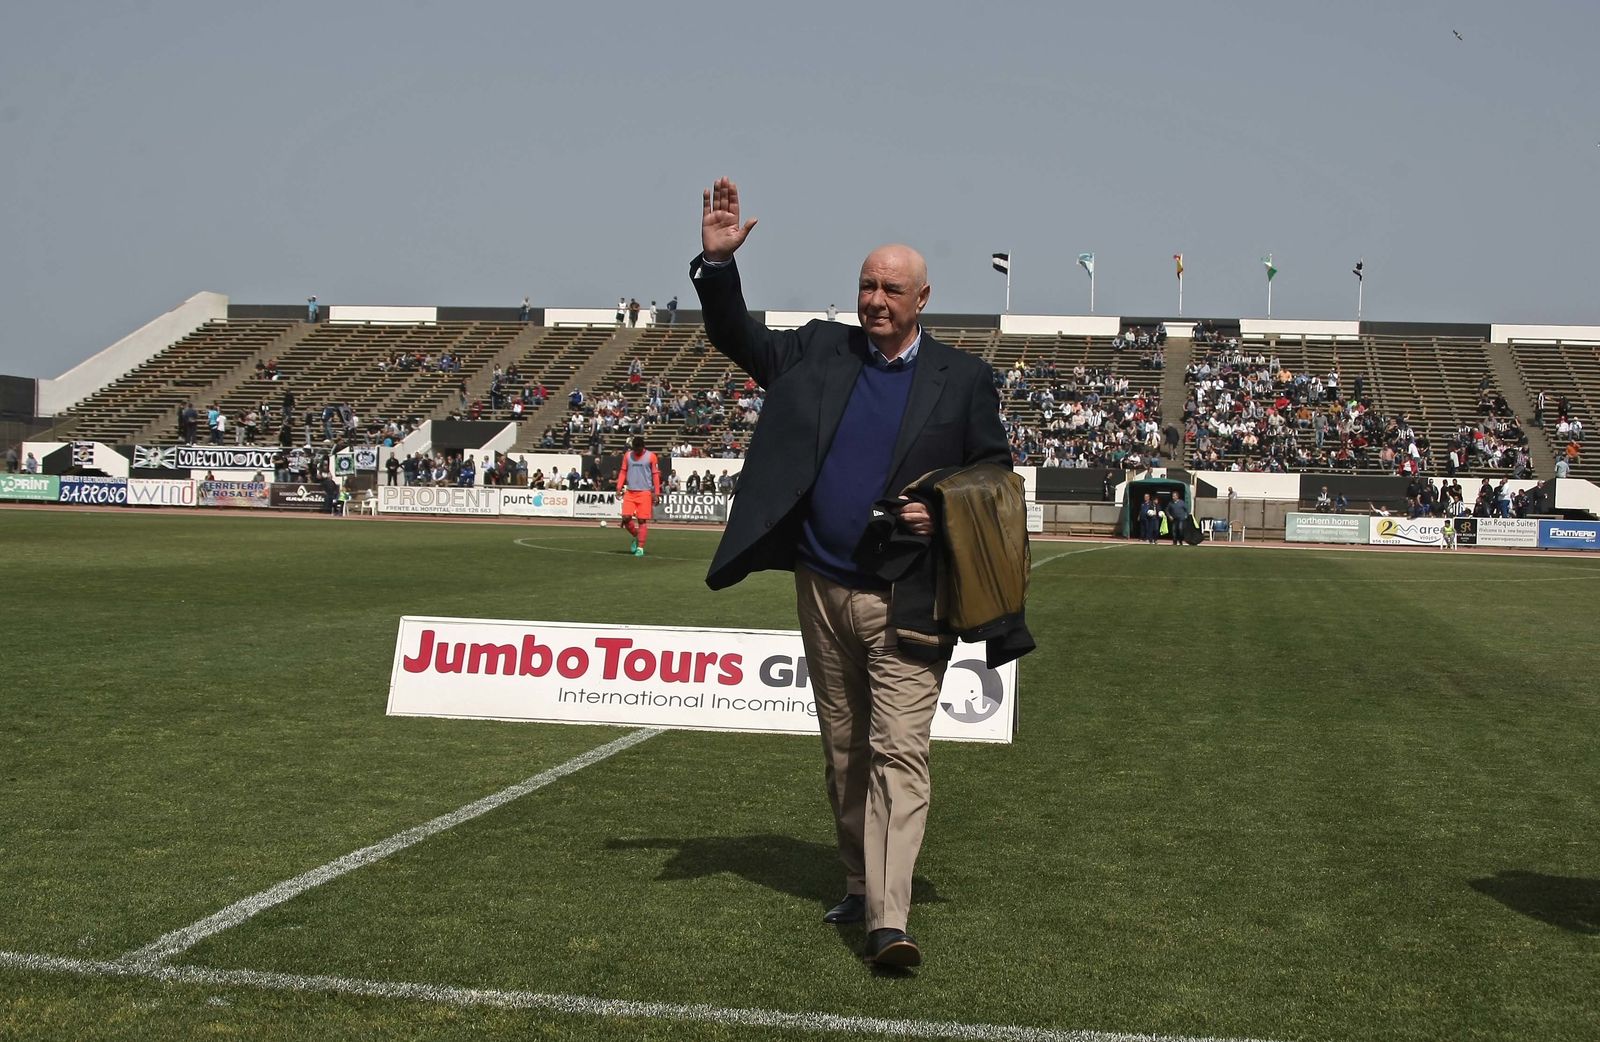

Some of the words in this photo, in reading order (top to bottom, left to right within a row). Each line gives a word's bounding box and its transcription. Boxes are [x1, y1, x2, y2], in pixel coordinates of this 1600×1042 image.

[179, 450, 233, 466] COLECTIVO
[60, 484, 127, 503] BARROSO
[212, 490, 256, 498] ROSAJE
[383, 487, 495, 507] PRODENT
[576, 494, 615, 505] MIPAN
[1296, 516, 1330, 525] northern
[1332, 518, 1359, 526] homes
[1494, 519, 1515, 528] Roque
[558, 687, 704, 709] International
[711, 693, 818, 717] Incoming
